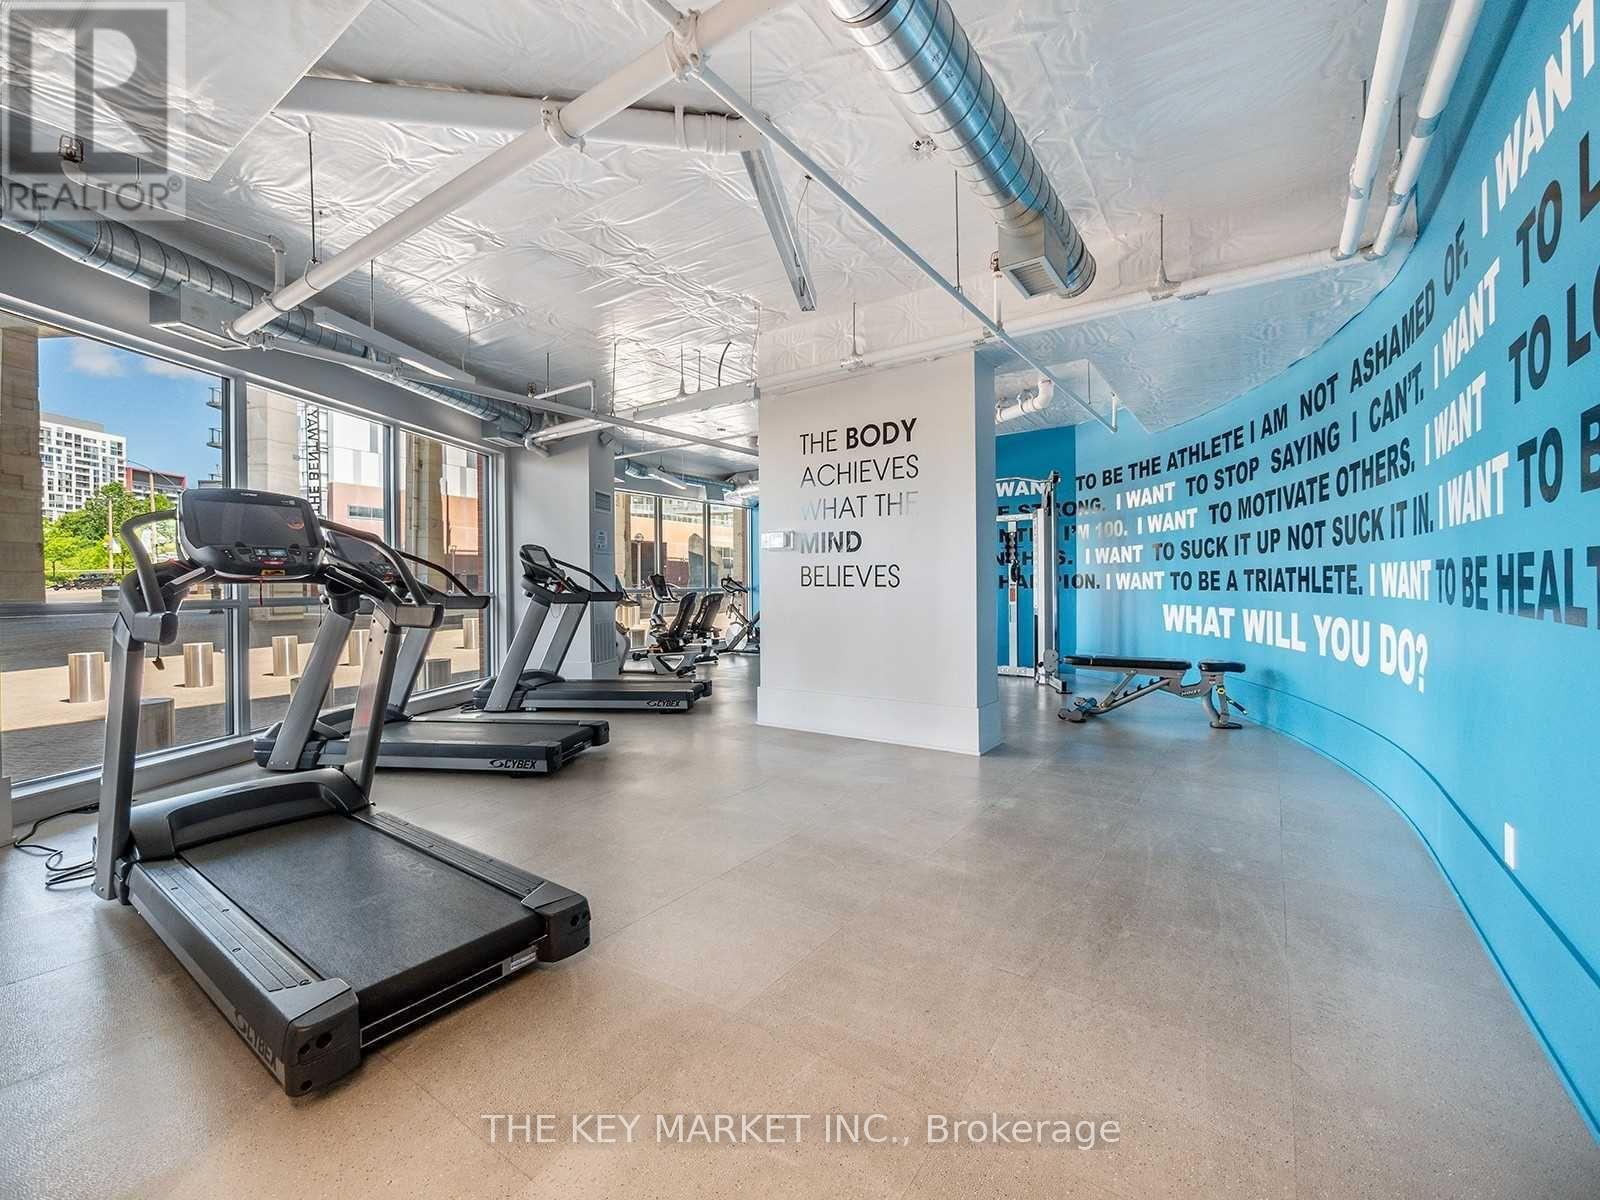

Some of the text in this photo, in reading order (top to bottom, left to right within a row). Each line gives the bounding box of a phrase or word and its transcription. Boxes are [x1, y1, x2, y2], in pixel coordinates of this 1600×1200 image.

[1075, 473, 1097, 491] TO
[1102, 466, 1123, 486] BE
[1128, 456, 1161, 480] THE
[1167, 426, 1244, 472] ATHLETE
[1249, 420, 1255, 444] I
[1261, 403, 1288, 440] AM
[1300, 372, 1339, 421] NOT
[1350, 278, 1435, 393] ASHAMED
[1444, 219, 1468, 297] OF.
[1481, 175, 1488, 239] I
[1495, 0, 1595, 212] WANT
[1116, 493, 1121, 511] I
[1126, 481, 1176, 509] WANT
[1185, 473, 1208, 497] TO
[1214, 457, 1259, 490] STOP
[1270, 421, 1340, 474] SAYING
[1352, 411, 1357, 443] I
[1369, 361, 1424, 433] CAN'T.
[1434, 344, 1439, 391] I
[1442, 256, 1500, 379] WANT
[1515, 180, 1563, 288] TO
[800, 418, 917, 455] THE BODY
[1064, 523, 1090, 541] I'M
[1096, 519, 1128, 538] 100.
[1137, 517, 1142, 534] I
[1147, 507, 1198, 533] WANT
[1208, 501, 1232, 525] TO
[1238, 472, 1329, 520] MOTIVATE
[1336, 437, 1415, 498] OTHERS.
[1425, 423, 1430, 466] I
[1434, 371, 1486, 460] WANT
[1508, 314, 1551, 404] TO
[800, 454, 919, 488] ACHIEVES
[801, 495, 867, 520] WHAT
[1085, 548, 1090, 565] I
[1095, 544, 1143, 565] WANT
[1152, 542, 1175, 561] TO
[1180, 535, 1228, 560] SUCK
[1234, 532, 1251, 556] IT
[1257, 528, 1280, 554] UP
[1287, 519, 1326, 551] NOT
[1332, 506, 1384, 547] SUCK
[1390, 500, 1407, 539] IT
[1413, 492, 1434, 536] IN.
[1438, 484, 1443, 530] I
[1447, 451, 1509, 527] WANT
[1517, 427, 1563, 508] TO
[801, 530, 862, 553] MIND
[800, 564, 901, 588] BELIEVES
[1106, 573, 1111, 590] I
[1116, 571, 1165, 591] WANT
[1170, 571, 1192, 591] TO
[1199, 570, 1221, 591] BE
[1226, 570, 1238, 591] A
[1243, 564, 1363, 596] TRIATHLETE.
[1369, 563, 1375, 597] I
[1380, 559, 1431, 601] WANT
[1435, 557, 1456, 606] TO
[1462, 555, 1488, 611] BE
[1162, 604, 1428, 694] WHAT WILL YOU DO?
[504, 759, 537, 769] CYBEX
